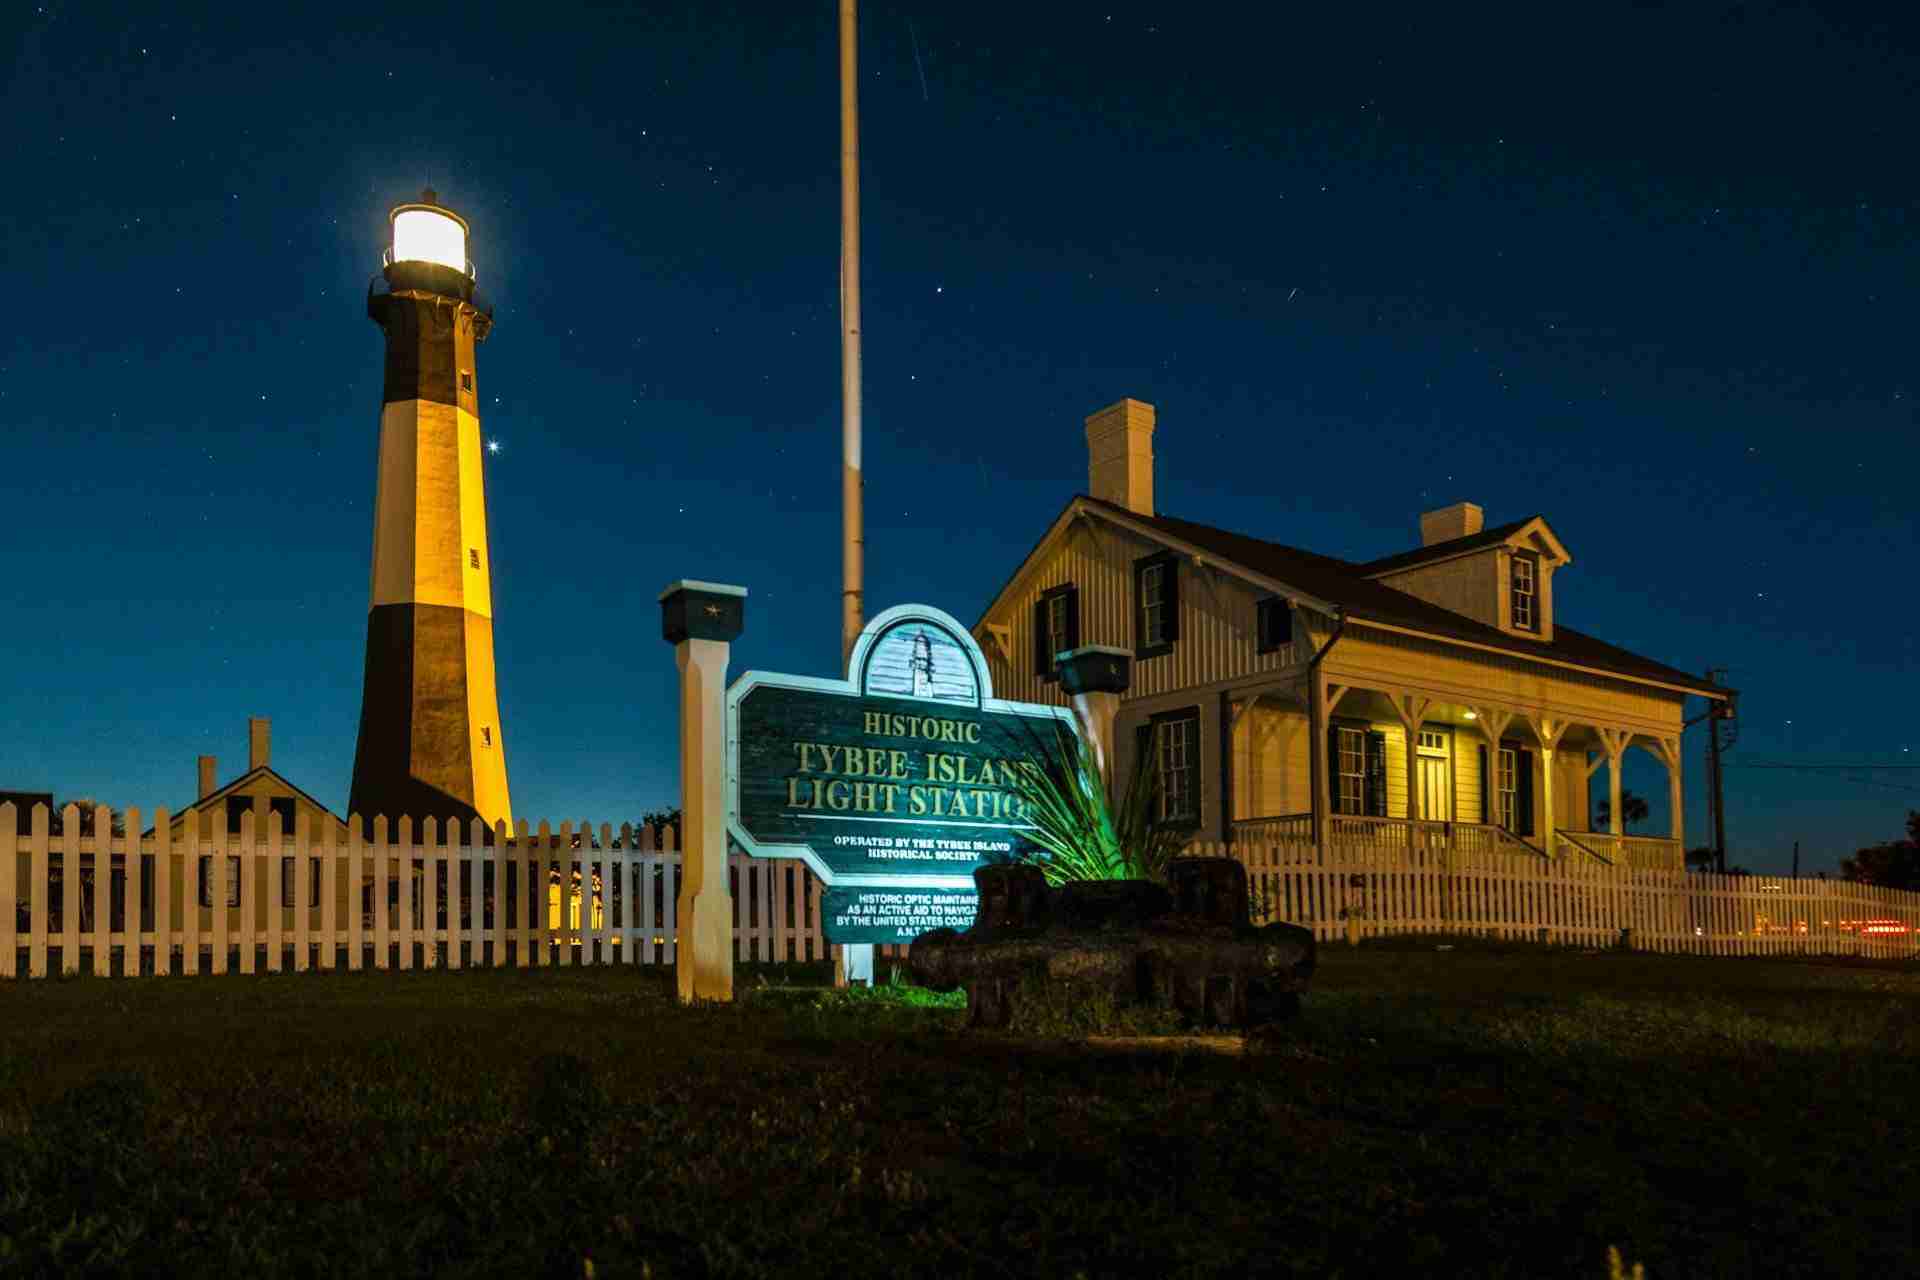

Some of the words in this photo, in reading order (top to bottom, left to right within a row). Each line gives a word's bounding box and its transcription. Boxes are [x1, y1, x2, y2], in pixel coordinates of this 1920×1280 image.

[864, 711, 981, 744] HISTORIC
[793, 742, 909, 780] TYBEE
[786, 776, 901, 813] LIGHT
[909, 785, 1034, 820] STATIO
[833, 835, 893, 847] OPERATED
[895, 837, 910, 848] BY
[911, 838, 934, 849] THE
[936, 839, 972, 850] TYBEE
[973, 841, 1011, 852] ISLAND
[868, 848, 933, 859] HISTORICAL
[935, 850, 980, 861] SOCIETY
[858, 893, 902, 904] HISTORIC
[904, 894, 931, 905] OPTIC
[932, 894, 979, 905] MAINTAINE
[847, 904, 860, 915] AS
[863, 904, 877, 915] AN
[878, 904, 911, 916] ACTIVE
[912, 905, 929, 916] AID
[930, 905, 943, 916] TO
[944, 905, 977, 916] NAVIGA
[836, 915, 850, 926] BY
[852, 915, 872, 926] THE
[872, 915, 907, 926] UNITED
[908, 916, 943, 927] STATES
[945, 916, 974, 927] COAST
